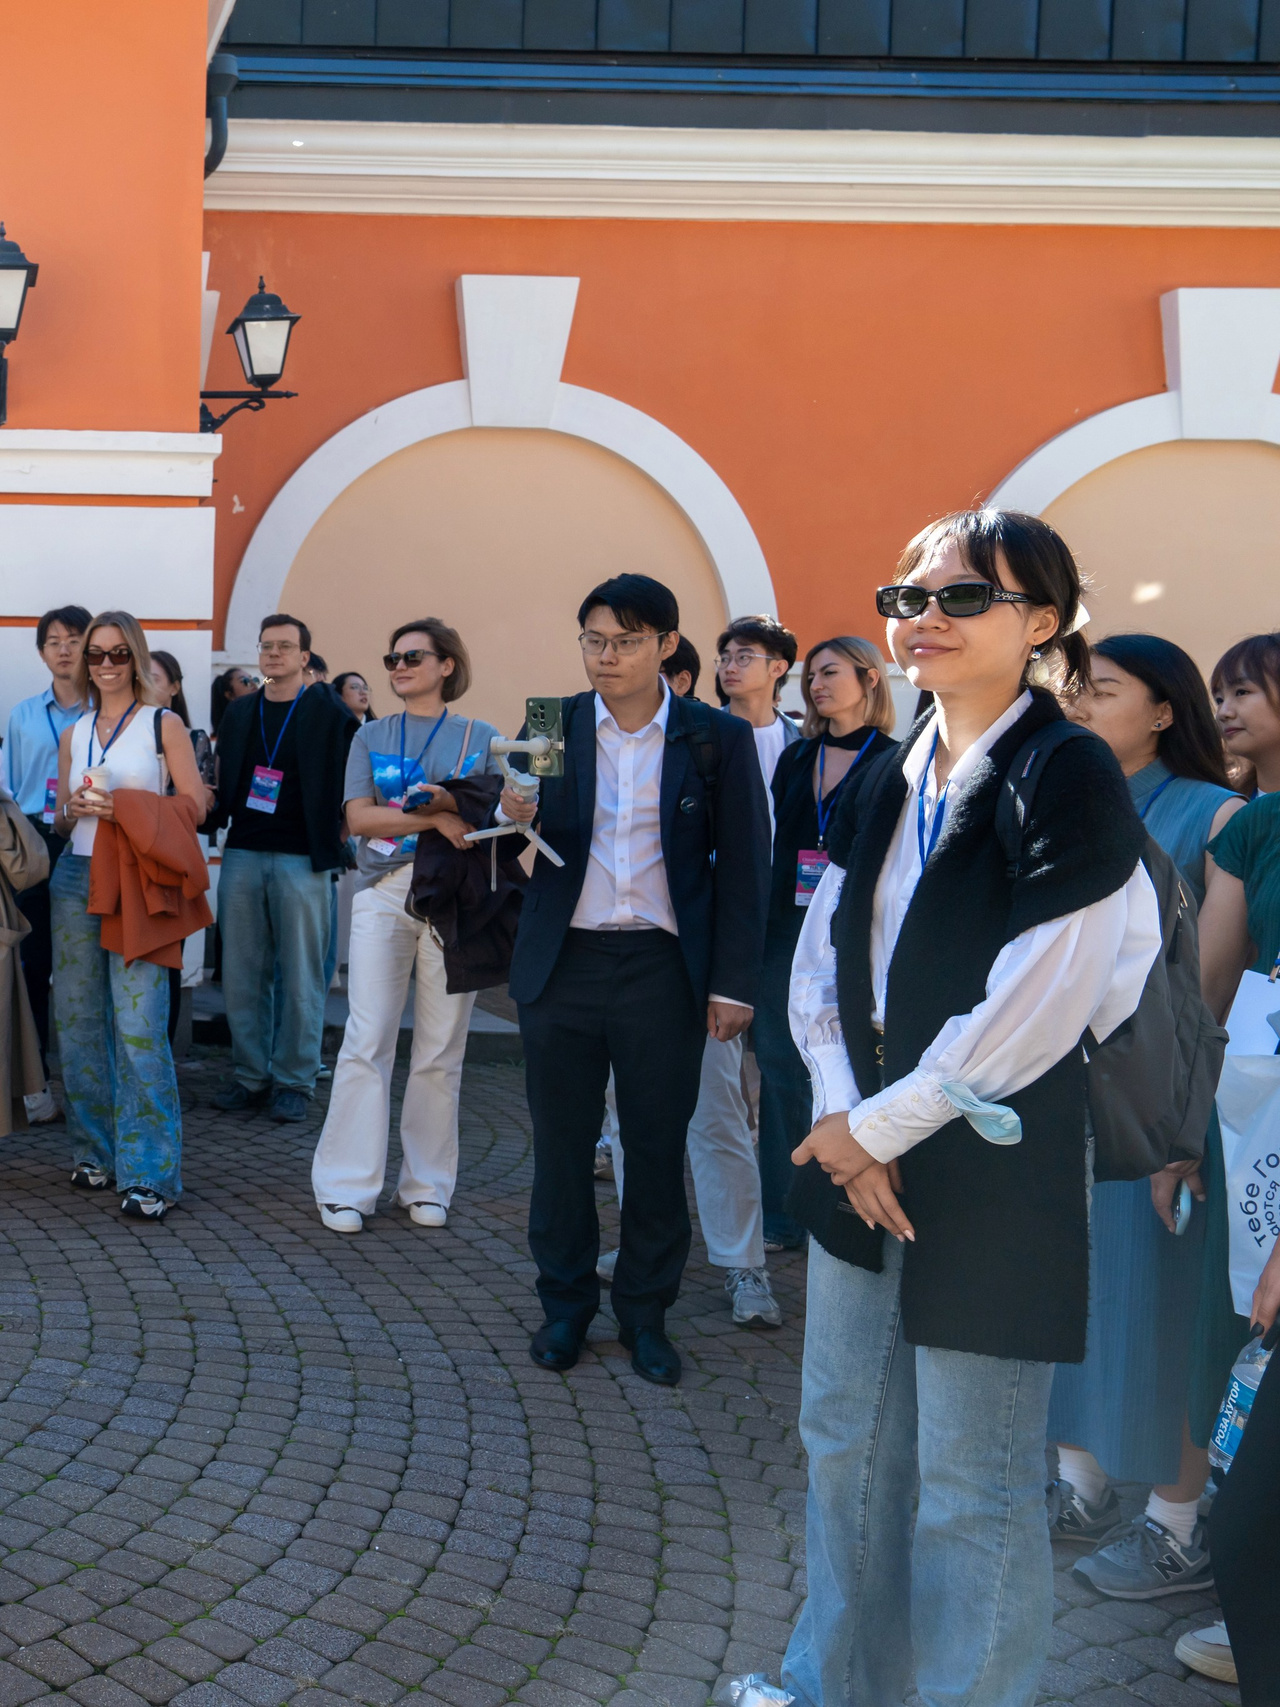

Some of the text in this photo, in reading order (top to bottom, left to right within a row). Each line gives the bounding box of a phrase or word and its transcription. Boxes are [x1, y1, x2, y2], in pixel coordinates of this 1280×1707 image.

[1252, 1152, 1280, 1179] Го
[1214, 1417, 1230, 1447] РОЗА
[1224, 1381, 1241, 1418] ХУТОР
